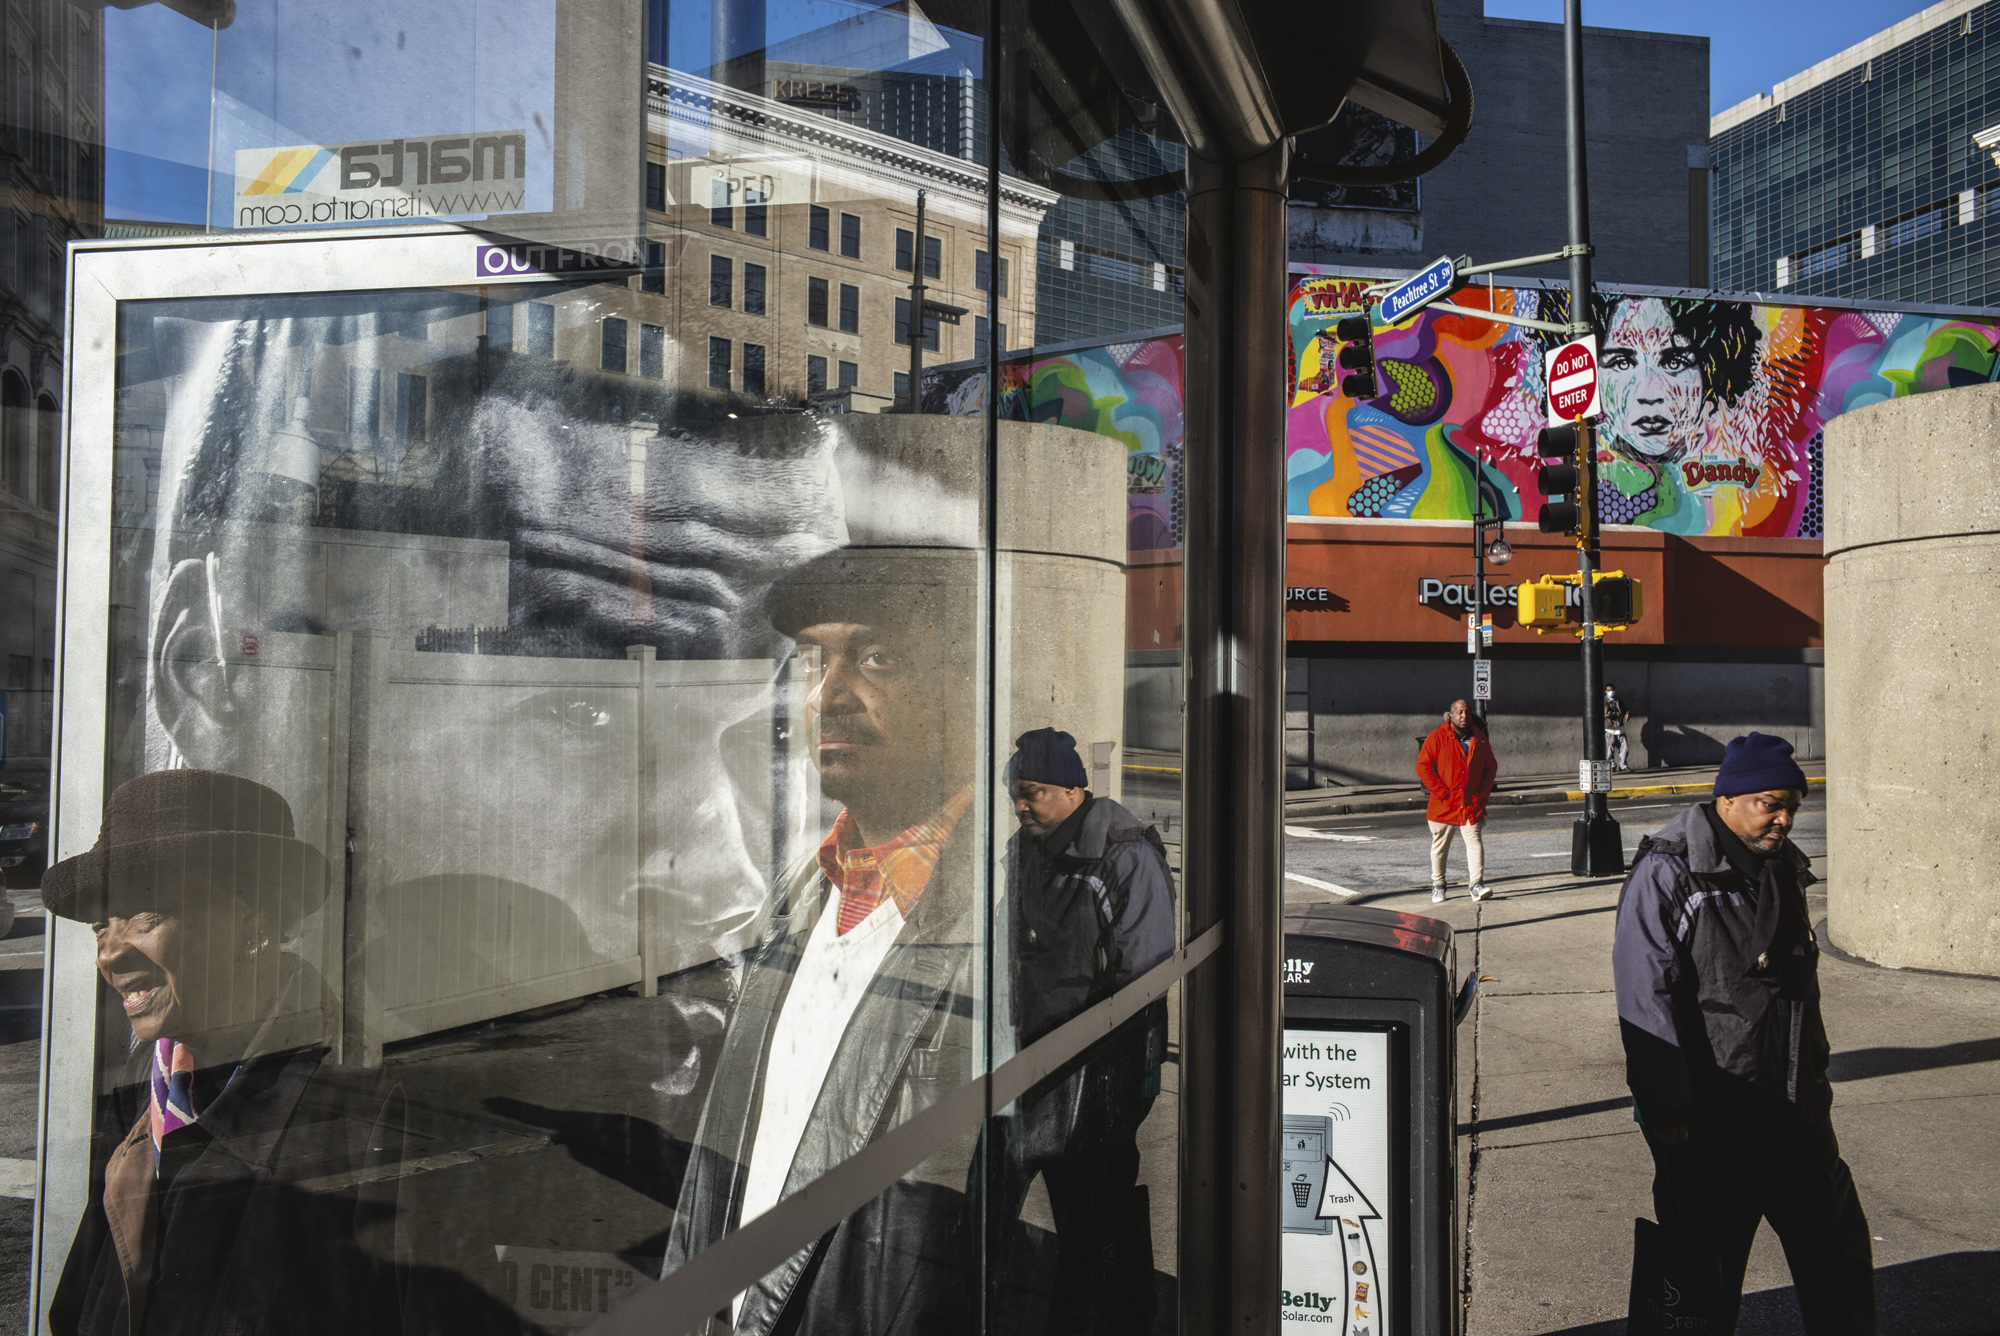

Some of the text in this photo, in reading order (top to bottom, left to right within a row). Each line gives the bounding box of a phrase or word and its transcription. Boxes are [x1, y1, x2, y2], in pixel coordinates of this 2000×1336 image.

[773, 79, 850, 101] KRESS
[726, 174, 775, 206] PED
[1392, 266, 1451, 312] Peachtree St SW
[1557, 353, 1588, 376] DO NOT
[1559, 389, 1587, 409] ENTER
[1682, 457, 1760, 489] Dandy
[1419, 578, 1518, 612] Payles
[1284, 1043, 1357, 1061] with the
[1283, 1071, 1370, 1091] ar System
[1329, 1194, 1355, 1204] Trash
[1282, 1290, 1334, 1312] Belly
[1282, 1310, 1333, 1323] Solar.com
